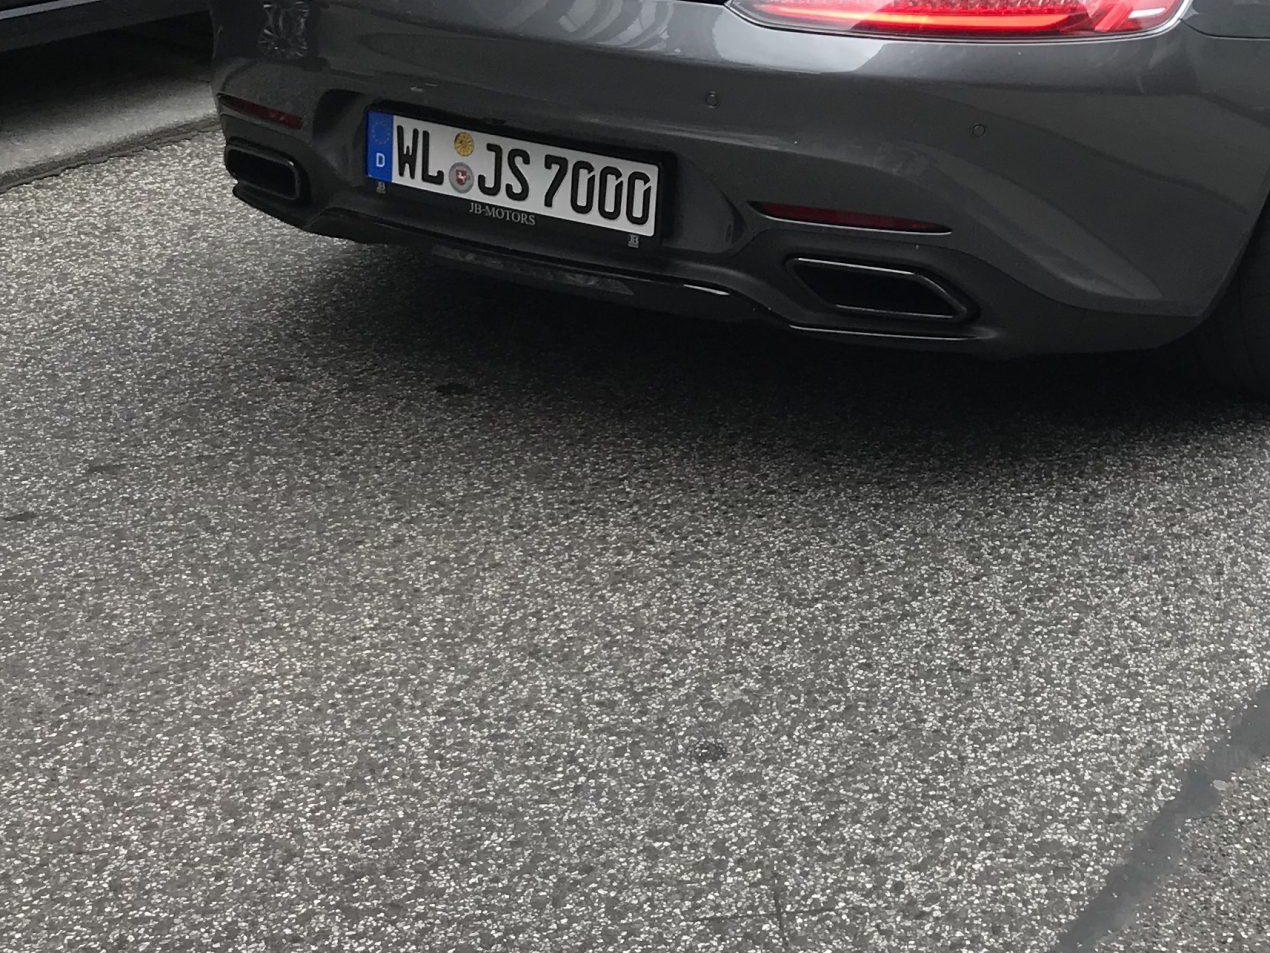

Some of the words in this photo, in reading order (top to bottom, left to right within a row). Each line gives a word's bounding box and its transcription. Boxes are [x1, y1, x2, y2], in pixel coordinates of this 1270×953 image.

[375, 152, 386, 168] D
[397, 124, 444, 186] WL
[477, 142, 531, 202] JS
[543, 154, 652, 226] 7000
[469, 201, 536, 227] JB-MOTORS
